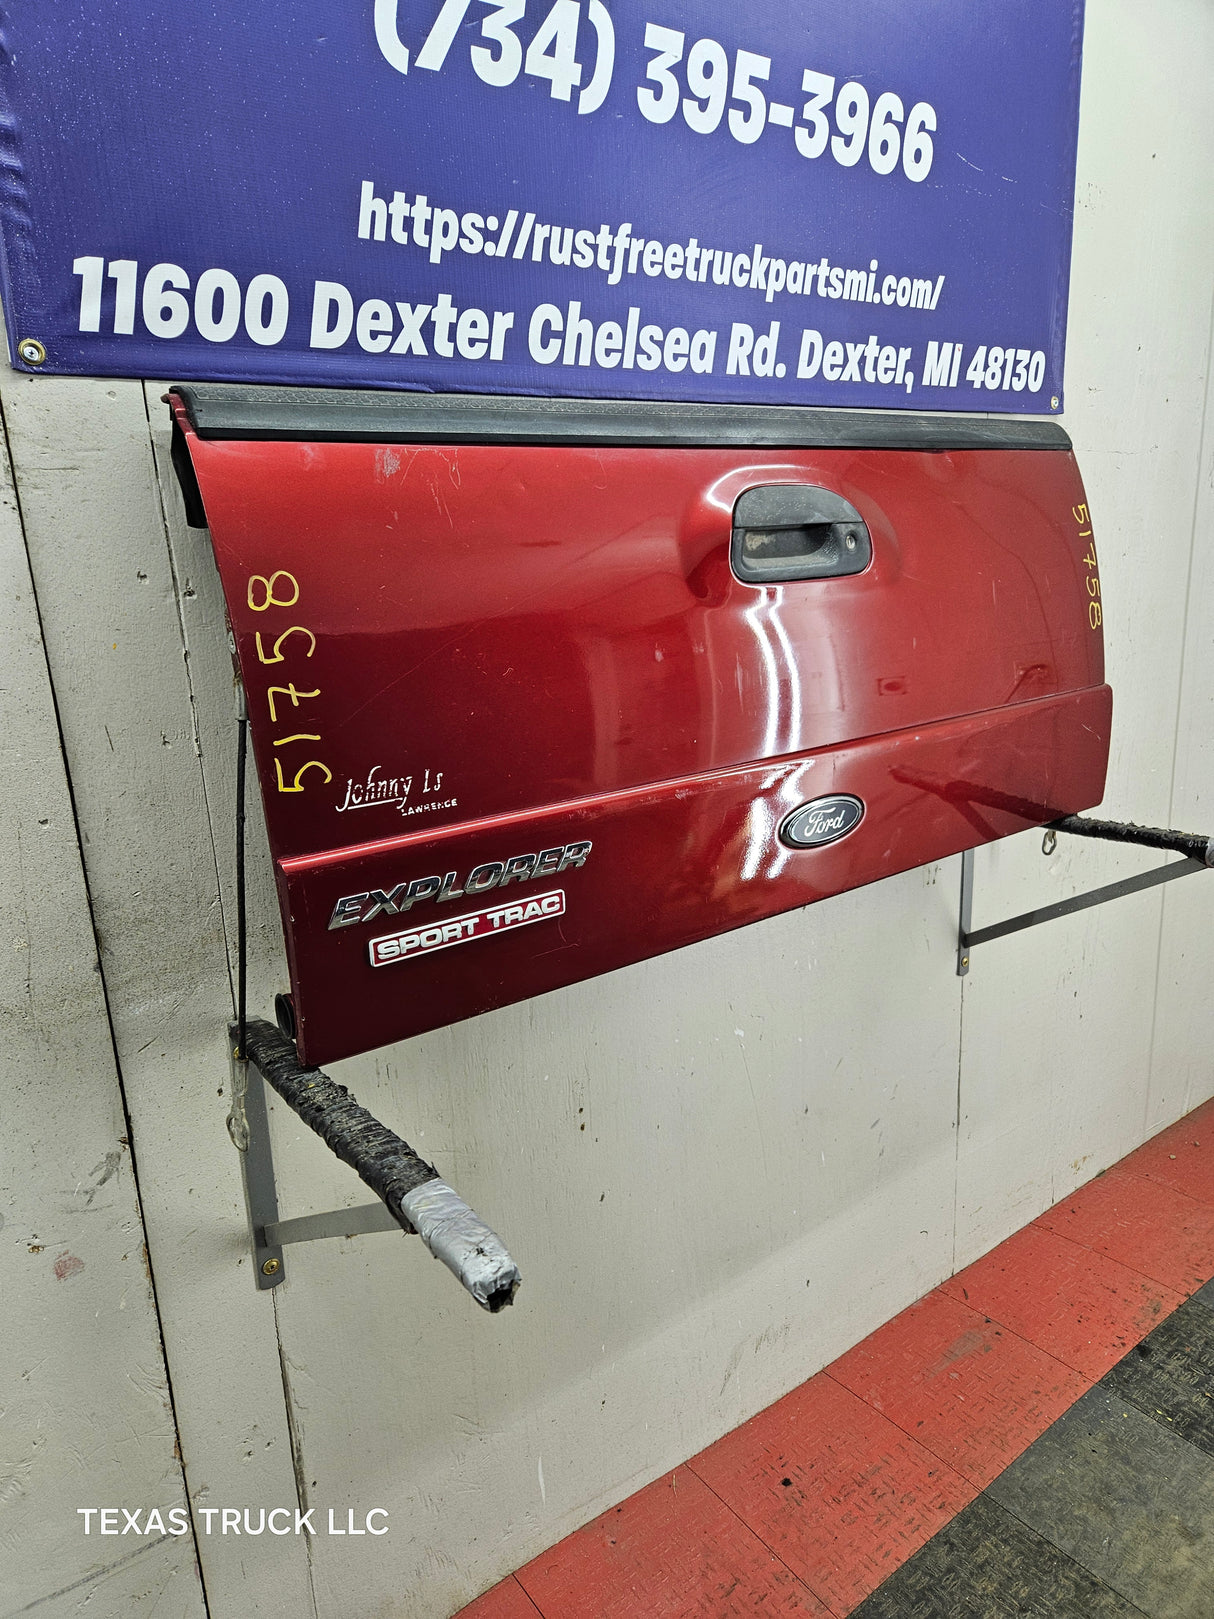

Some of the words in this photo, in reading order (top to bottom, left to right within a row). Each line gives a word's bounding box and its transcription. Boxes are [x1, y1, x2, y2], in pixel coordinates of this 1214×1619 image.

[637, 22, 937, 183] 395-3966
[357, 180, 946, 311] https://rustfreetruckpartsmi.com/
[73, 255, 289, 346] 11600
[309, 280, 515, 361] Dexter
[528, 300, 718, 374] Chelsea
[725, 322, 787, 379] Rd.
[796, 328, 914, 394] Dexter,
[921, 340, 964, 388] MI
[965, 345, 1047, 393] 48130
[1071, 503, 1103, 630] 51758
[247, 569, 333, 796] 51758
[335, 765, 413, 812] Johnny
[804, 806, 846, 837] Ford
[328, 840, 593, 930] EXPLORER
[376, 917, 479, 960] SPORT
[486, 894, 561, 928] TRAC
